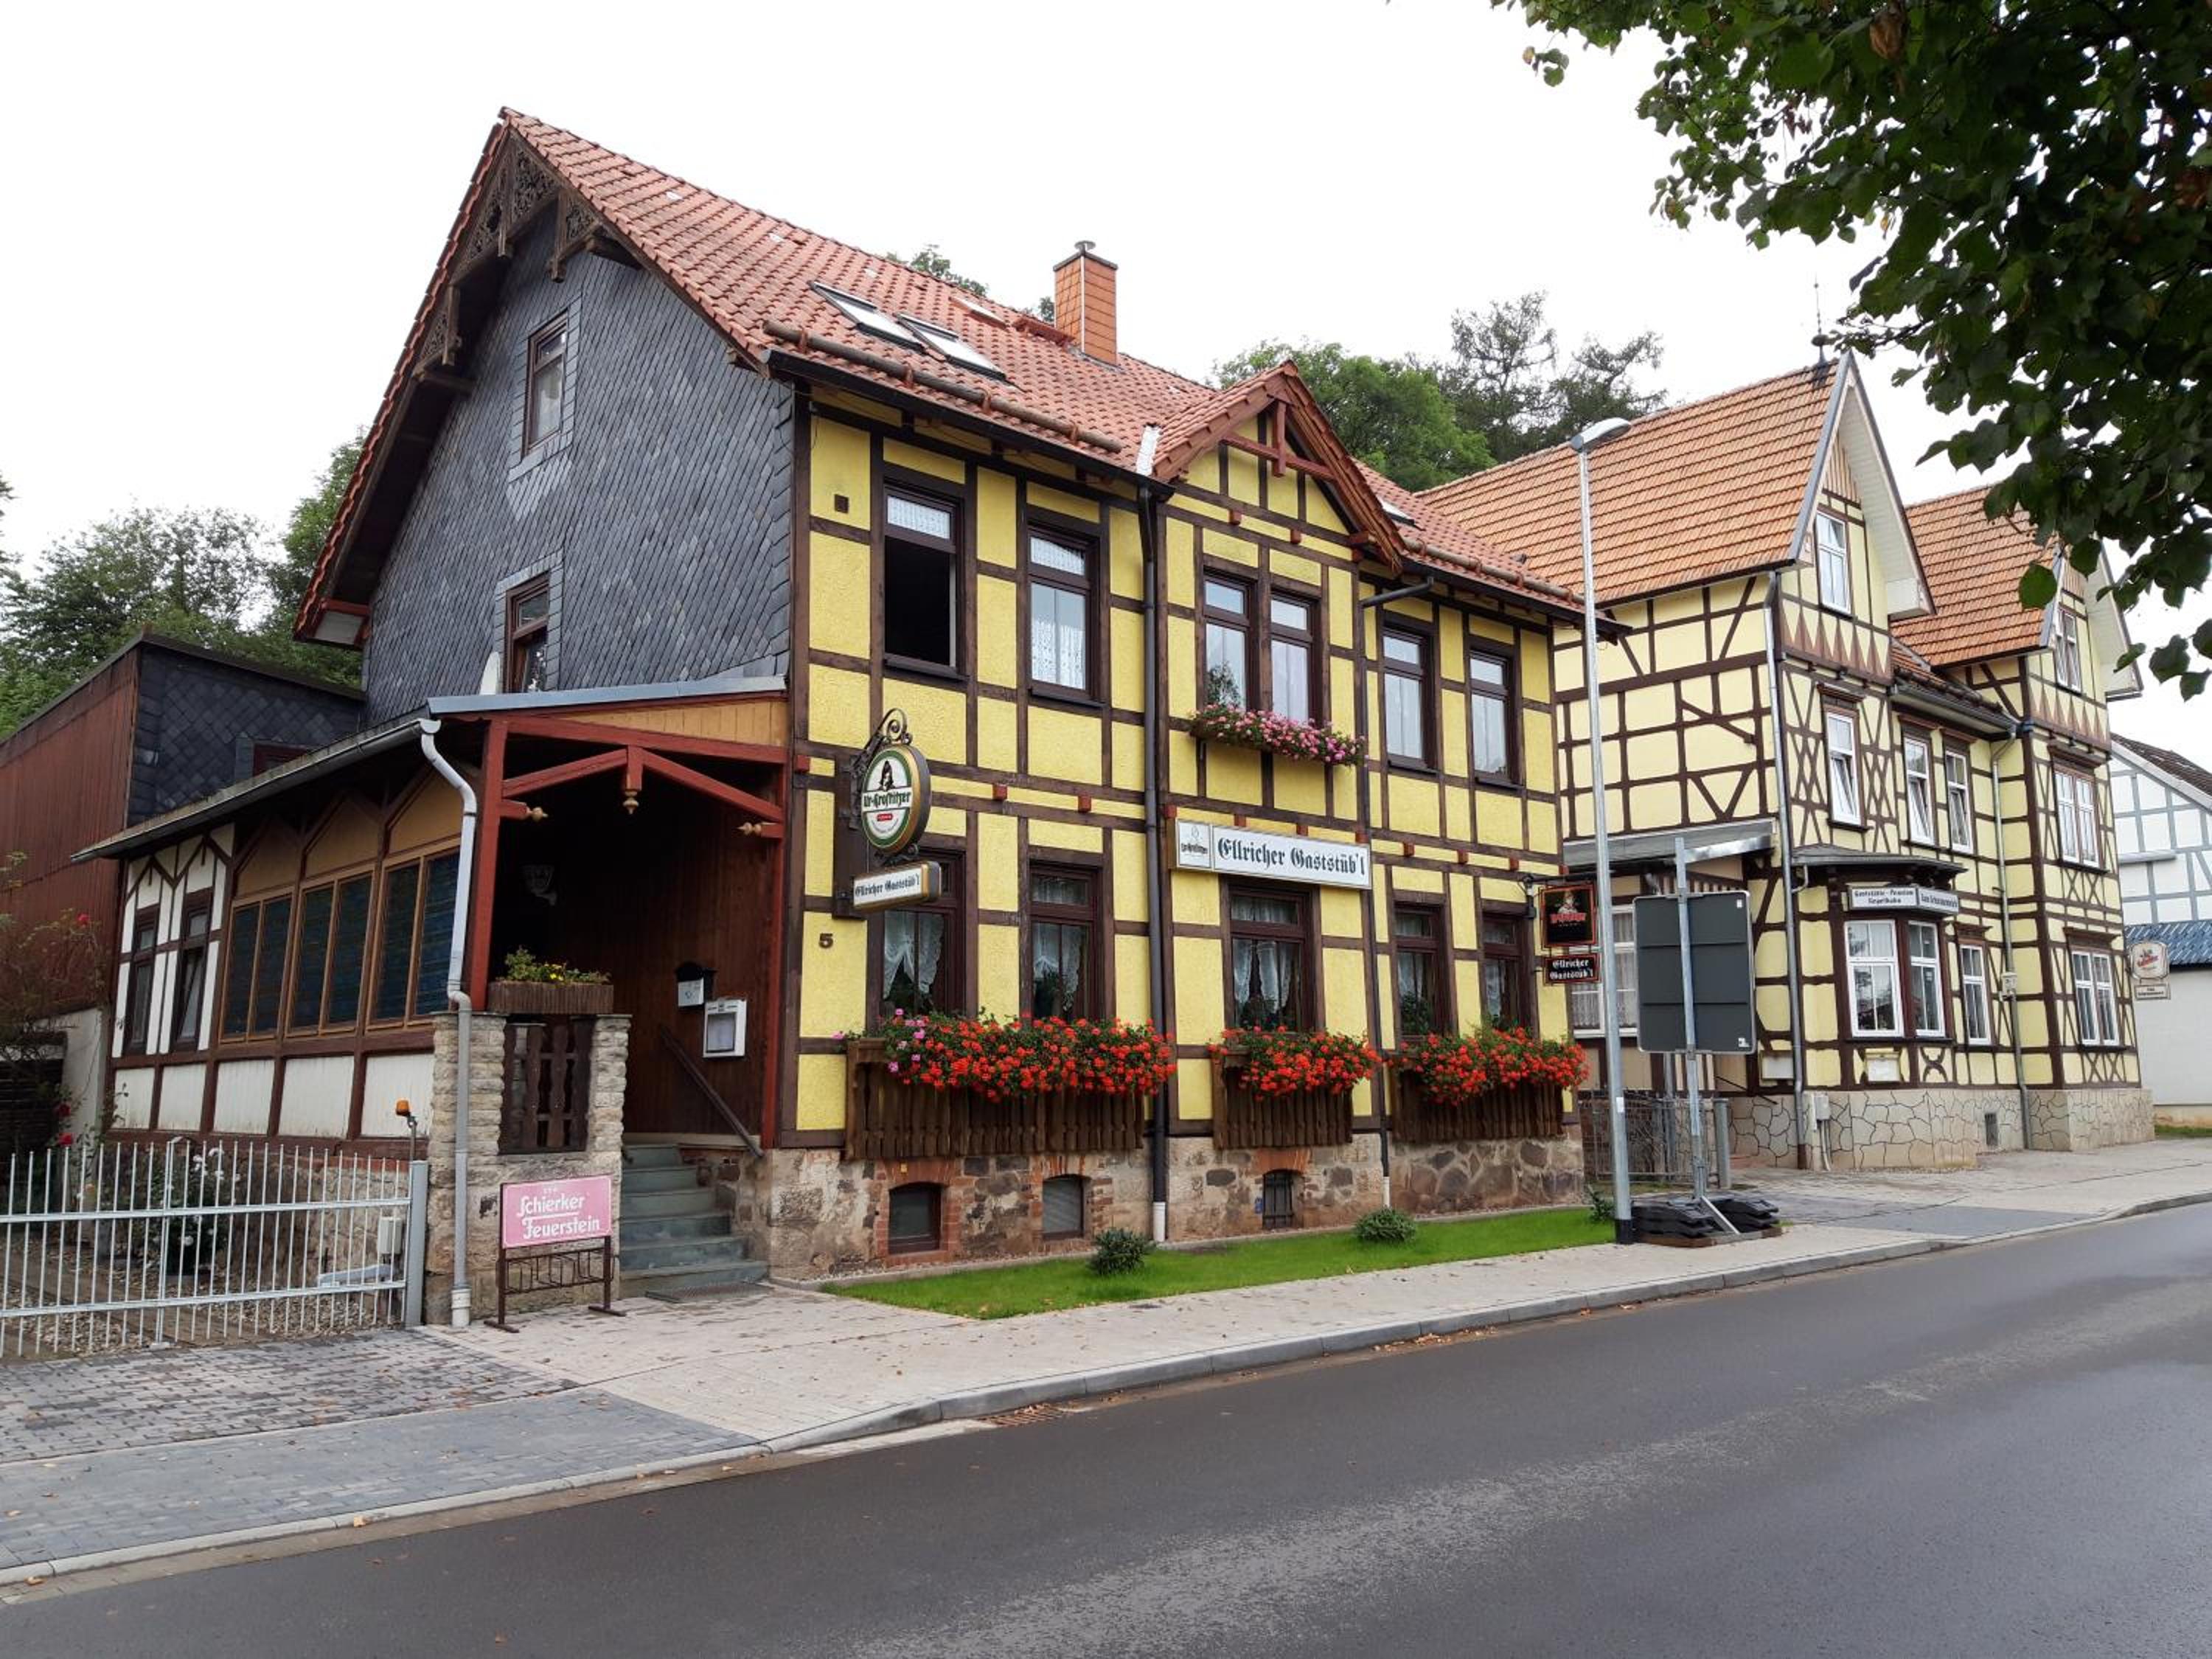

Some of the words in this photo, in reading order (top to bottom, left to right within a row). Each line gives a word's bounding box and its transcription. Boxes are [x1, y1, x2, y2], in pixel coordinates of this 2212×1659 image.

[1217, 838, 1285, 869] Ellricher
[819, 933, 833, 949] 5
[516, 1193, 585, 1217] Schierker
[521, 1215, 600, 1239] Feuerstein
